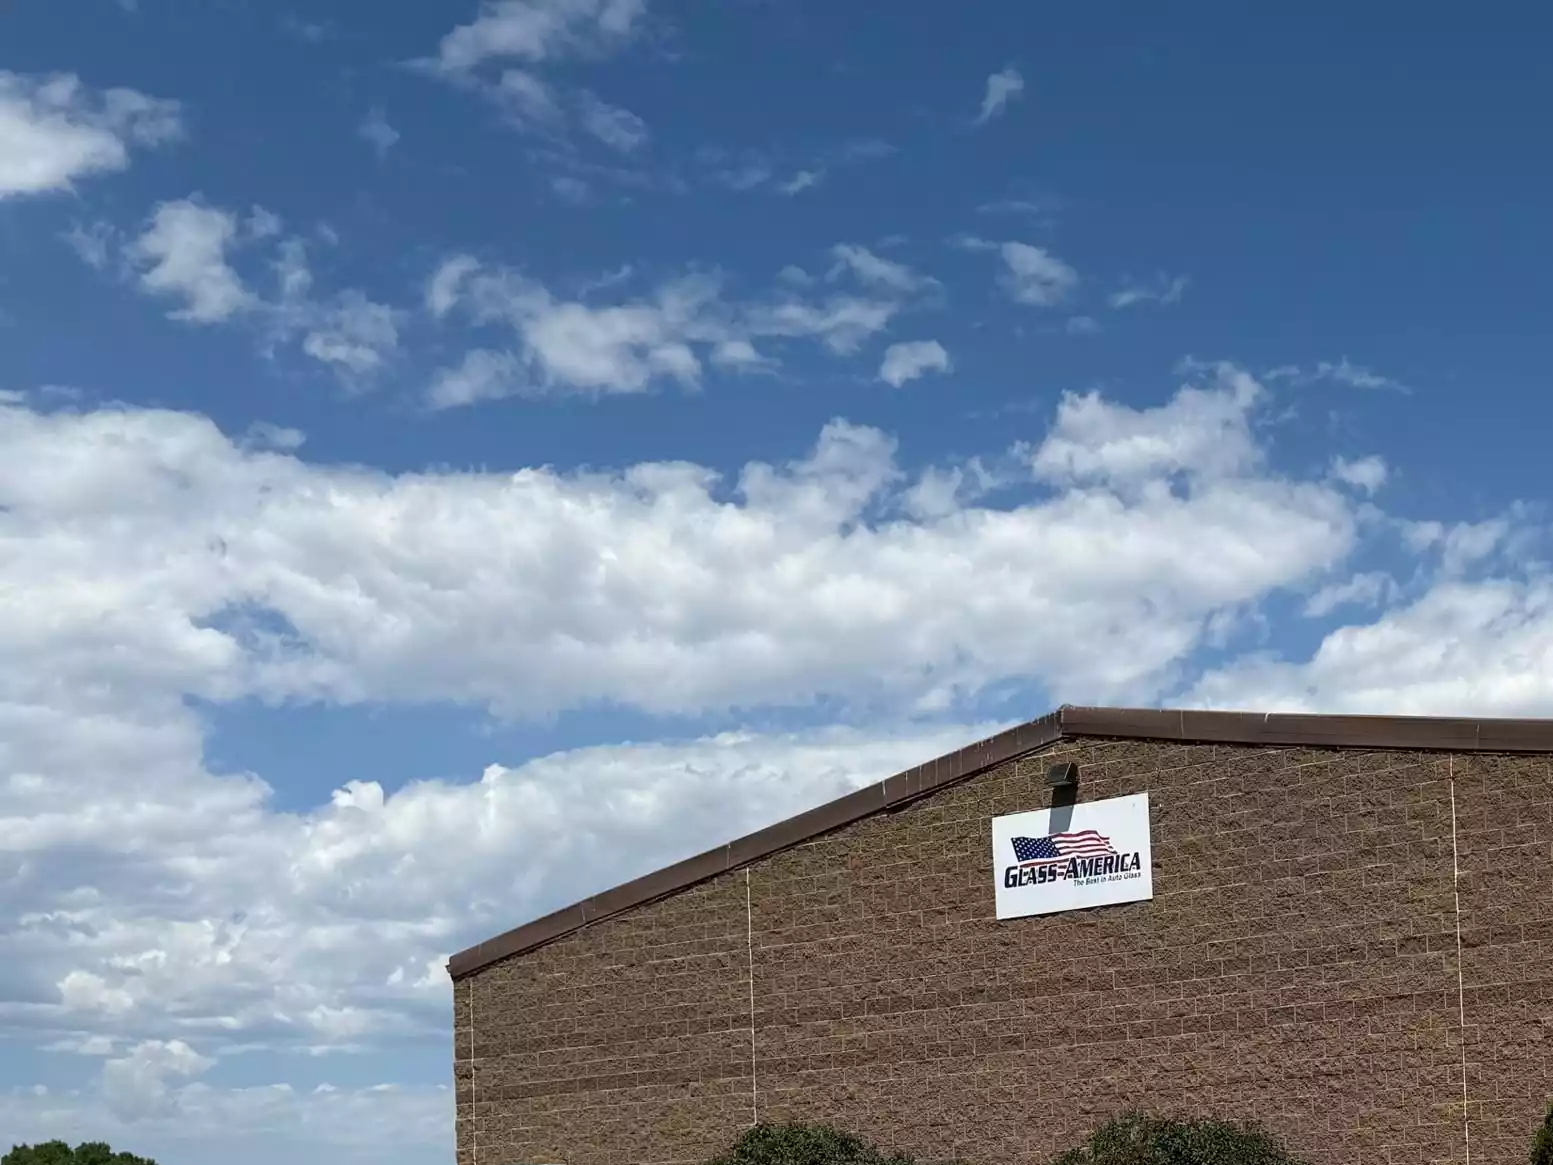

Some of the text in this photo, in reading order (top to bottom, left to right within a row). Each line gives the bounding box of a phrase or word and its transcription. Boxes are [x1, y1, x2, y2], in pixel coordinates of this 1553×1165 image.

[1086, 877, 1099, 885] Best
[1108, 872, 1122, 881] Auto
[1124, 871, 1141, 880] Glass
